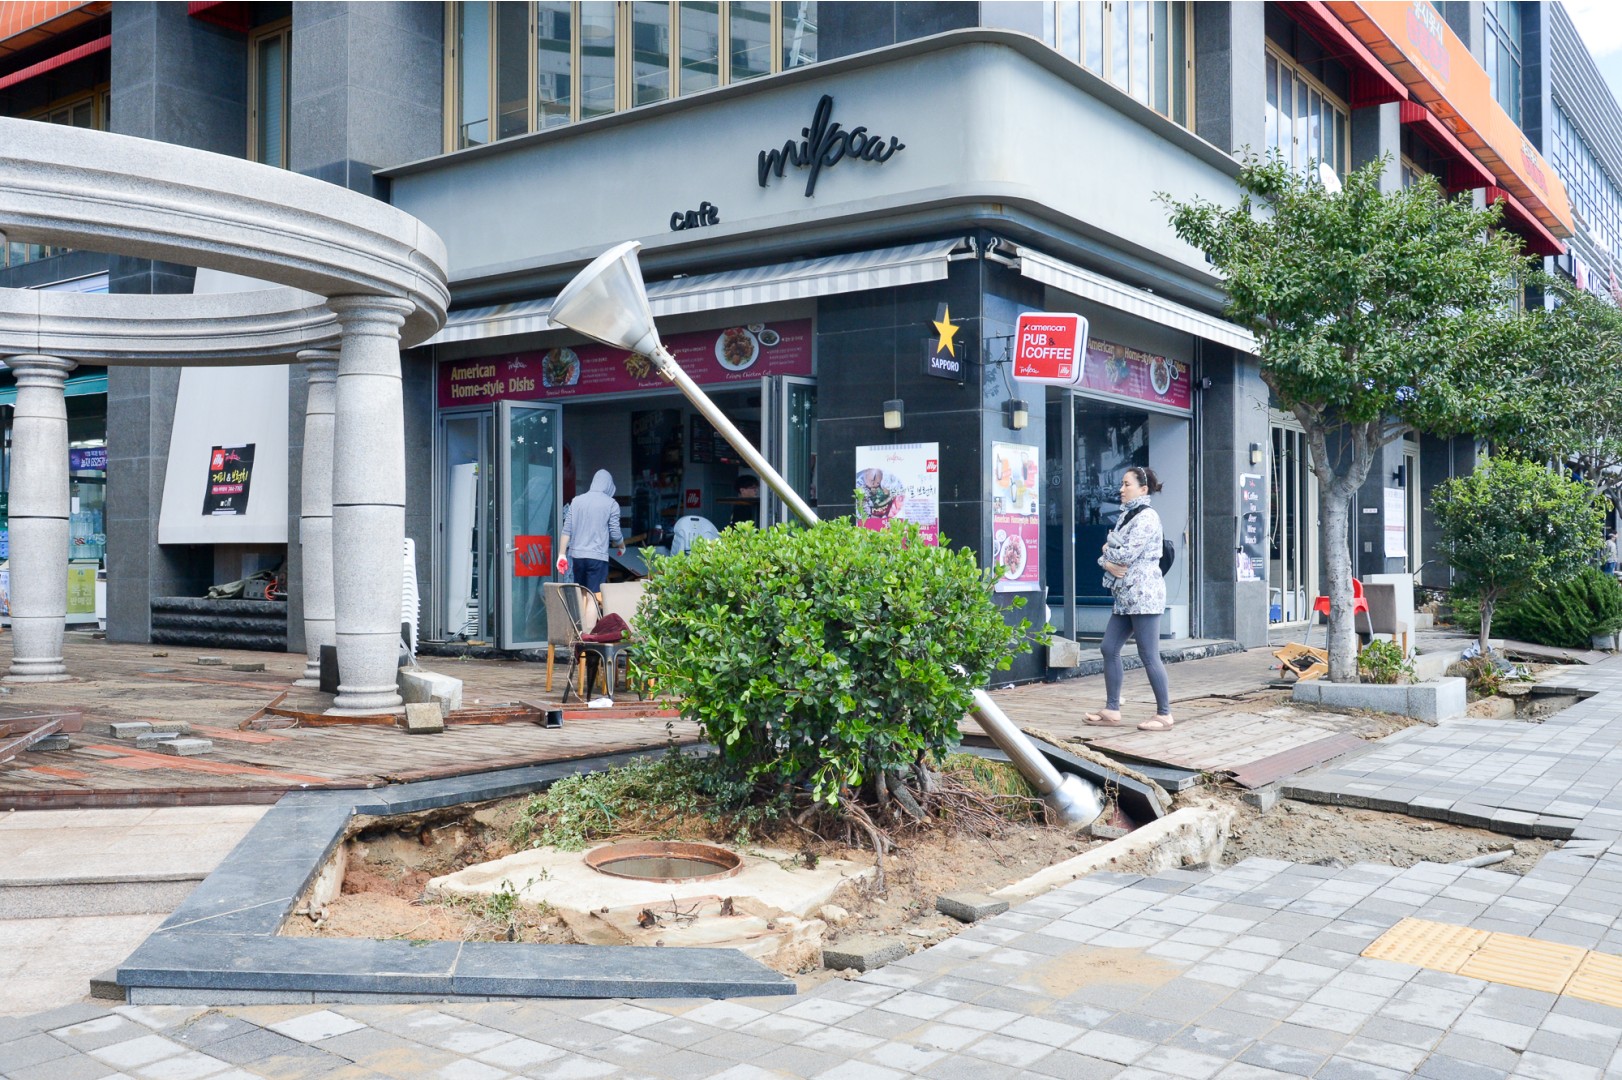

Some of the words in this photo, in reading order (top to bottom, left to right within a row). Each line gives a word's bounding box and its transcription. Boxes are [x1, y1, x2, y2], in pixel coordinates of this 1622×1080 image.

[669, 201, 720, 232] cafe
[1048, 337, 1055, 346] &
[1025, 347, 1072, 360] COFFEE
[450, 363, 496, 381] American
[931, 357, 960, 373] SAPPORO
[451, 379, 505, 398] Home-style
[508, 376, 535, 393] Dishs
[687, 492, 700, 506] illy
